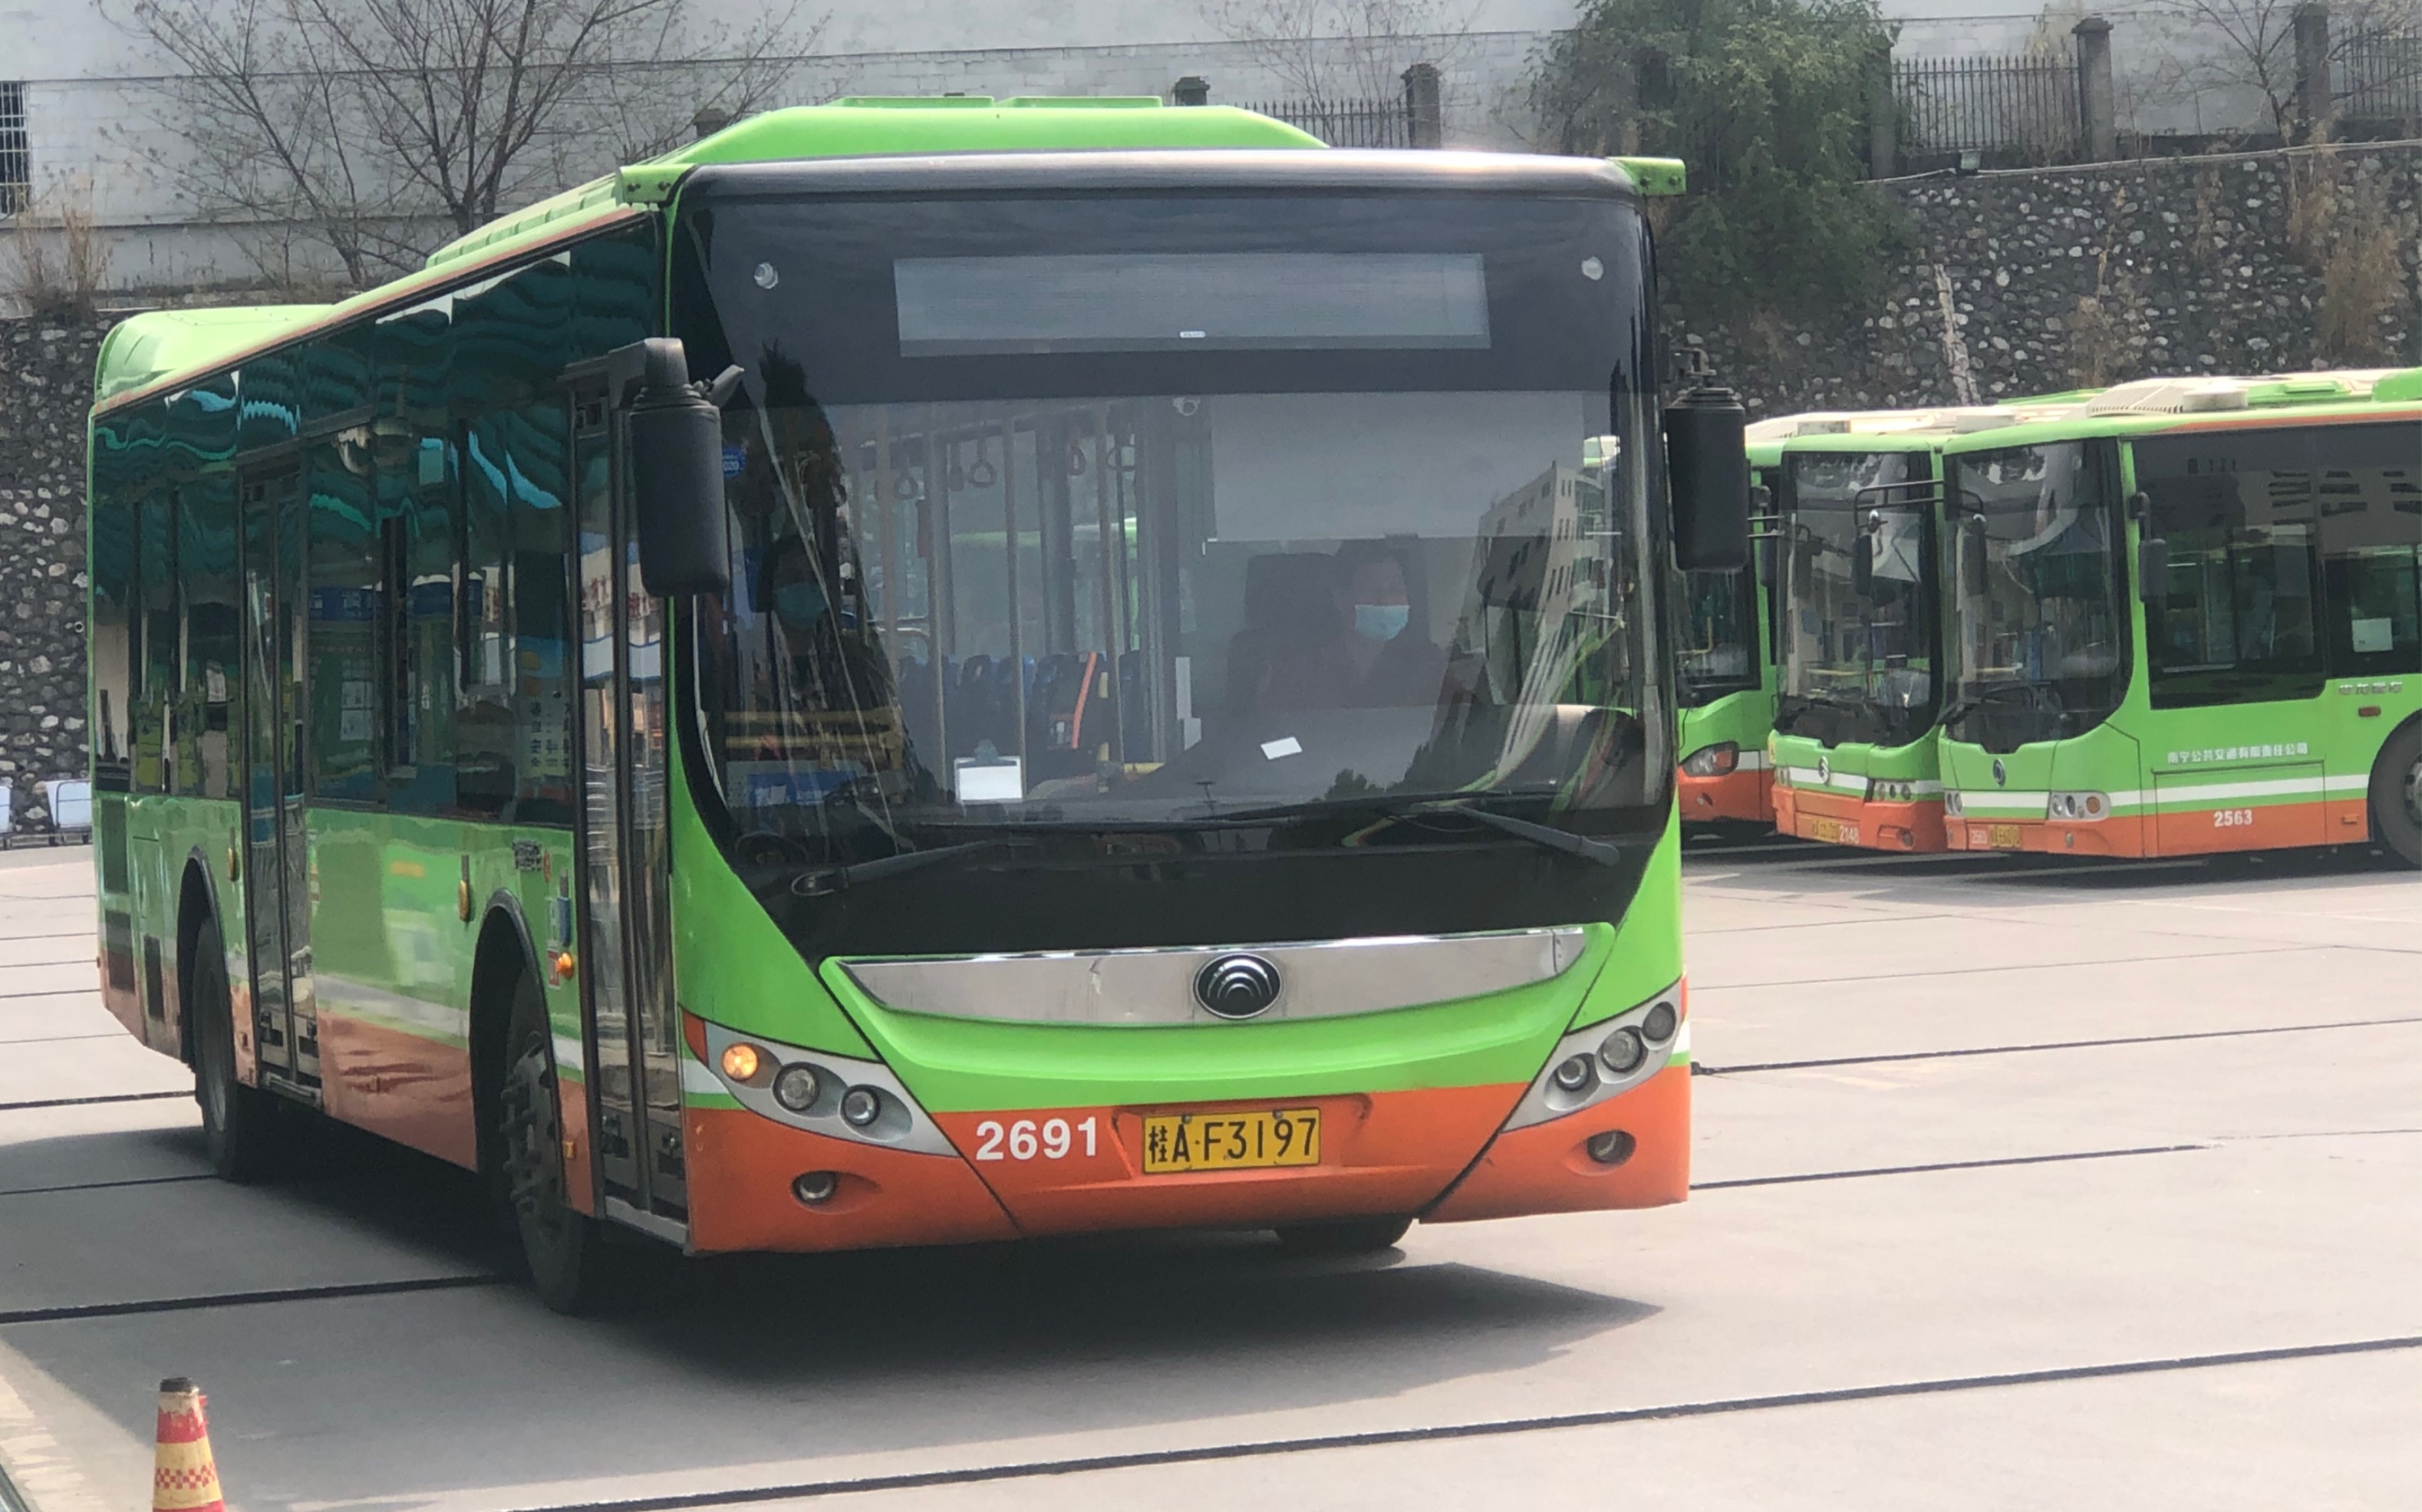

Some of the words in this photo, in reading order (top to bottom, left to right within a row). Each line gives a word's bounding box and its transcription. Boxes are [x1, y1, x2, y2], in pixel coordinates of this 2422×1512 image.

[2167, 742, 2308, 764] 南宁公共交通有限责任公司
[2213, 809, 2252, 828] 2563
[975, 1115, 1098, 1161] 2691
